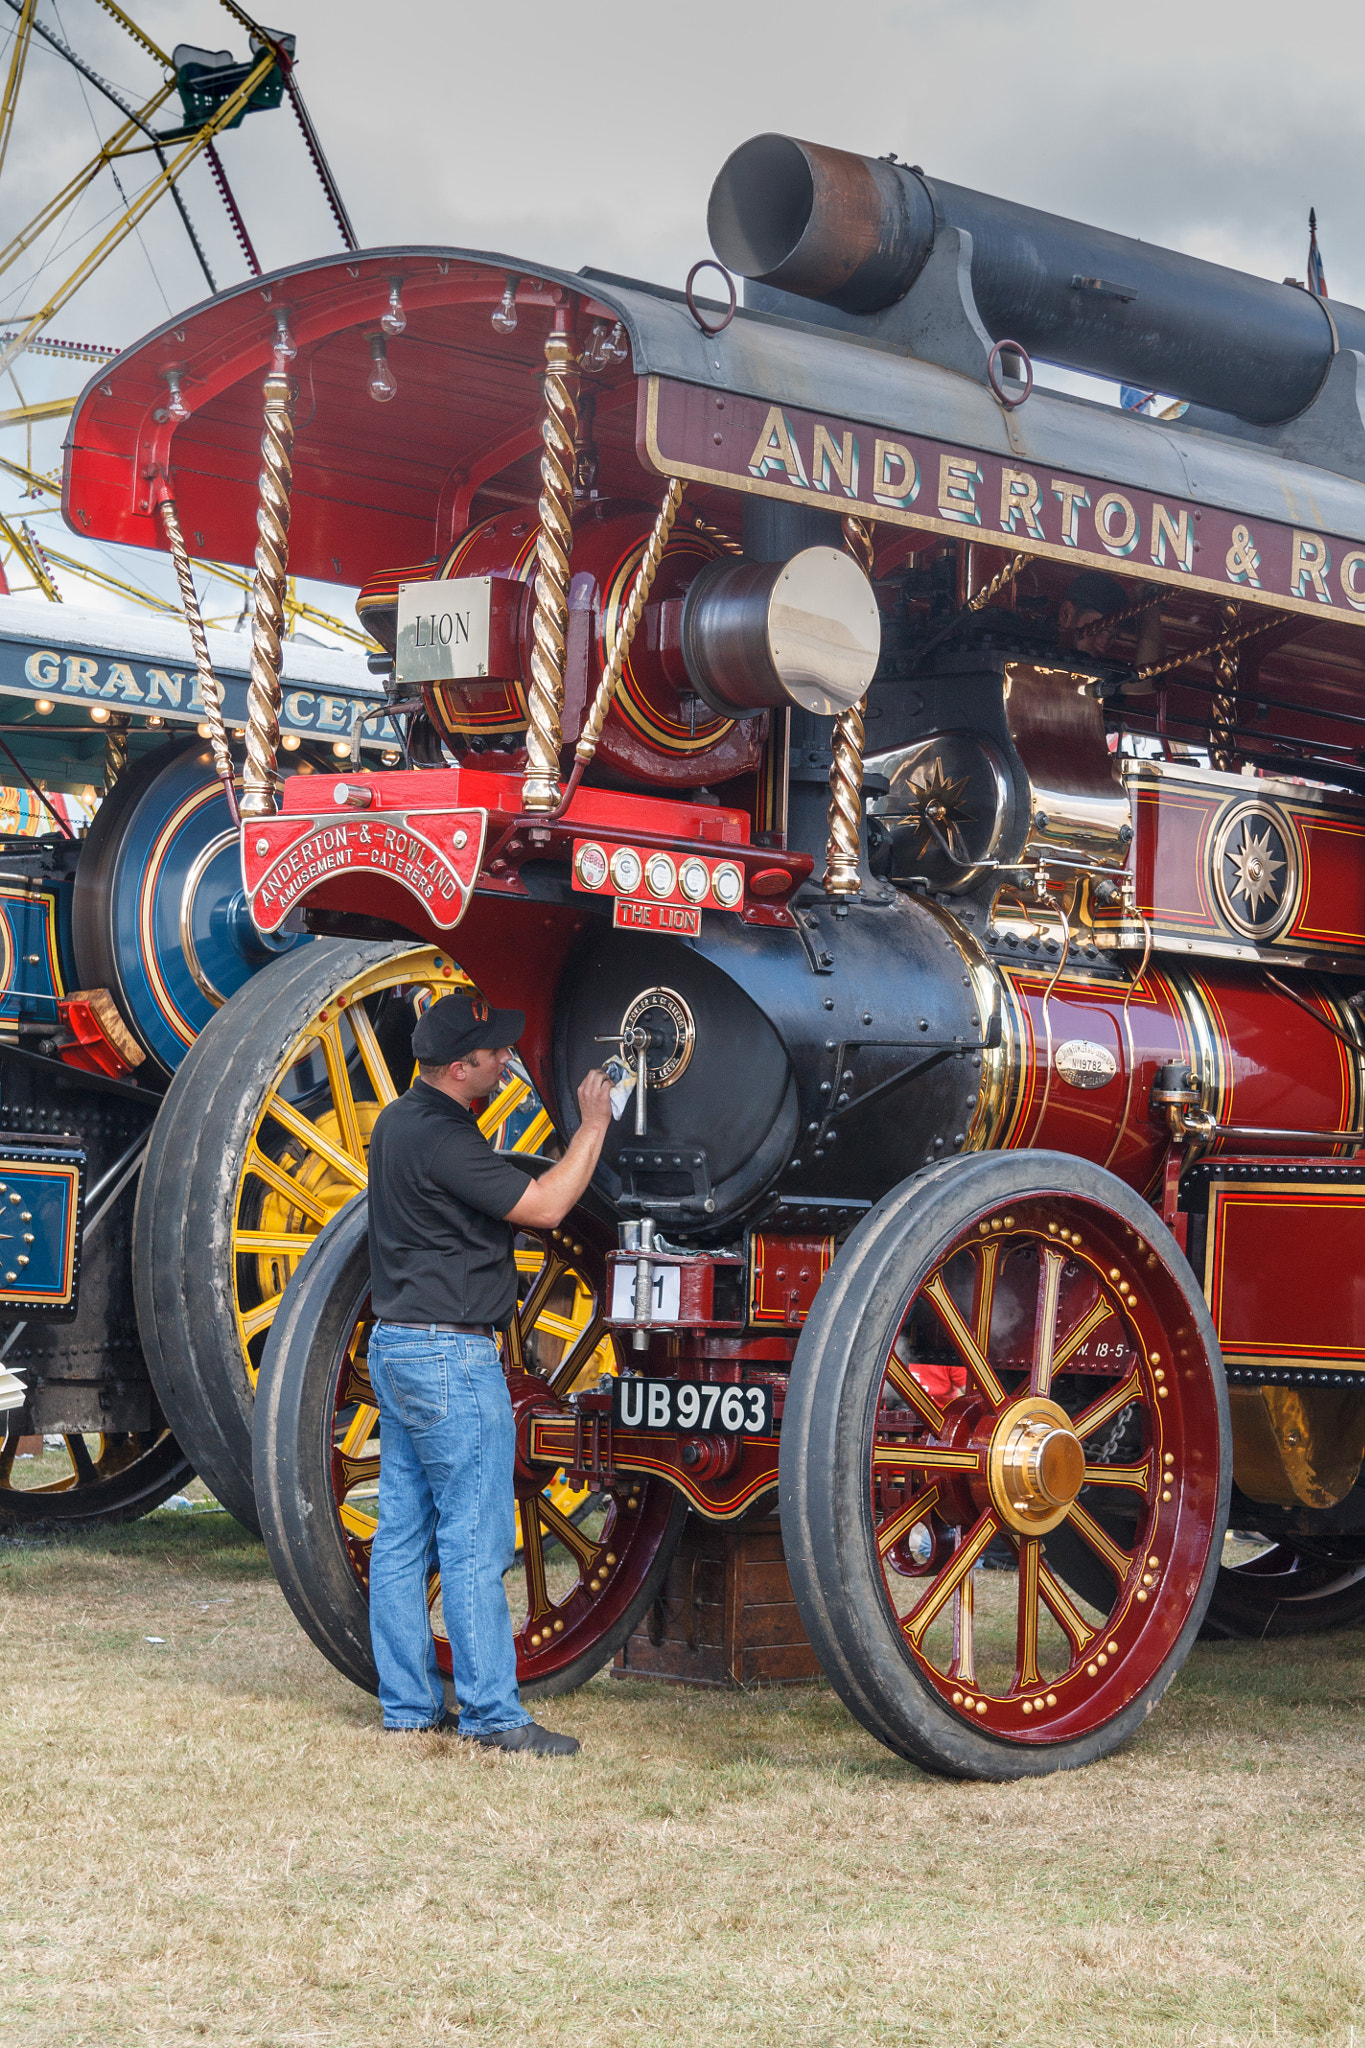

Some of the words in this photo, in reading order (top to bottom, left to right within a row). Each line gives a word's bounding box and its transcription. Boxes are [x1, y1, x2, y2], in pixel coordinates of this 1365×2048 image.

[748, 405, 1195, 573] ANDERTON
[1226, 523, 1264, 588] &
[415, 610, 471, 648] LION
[620, 903, 652, 926] THE
[659, 908, 697, 932] LION
